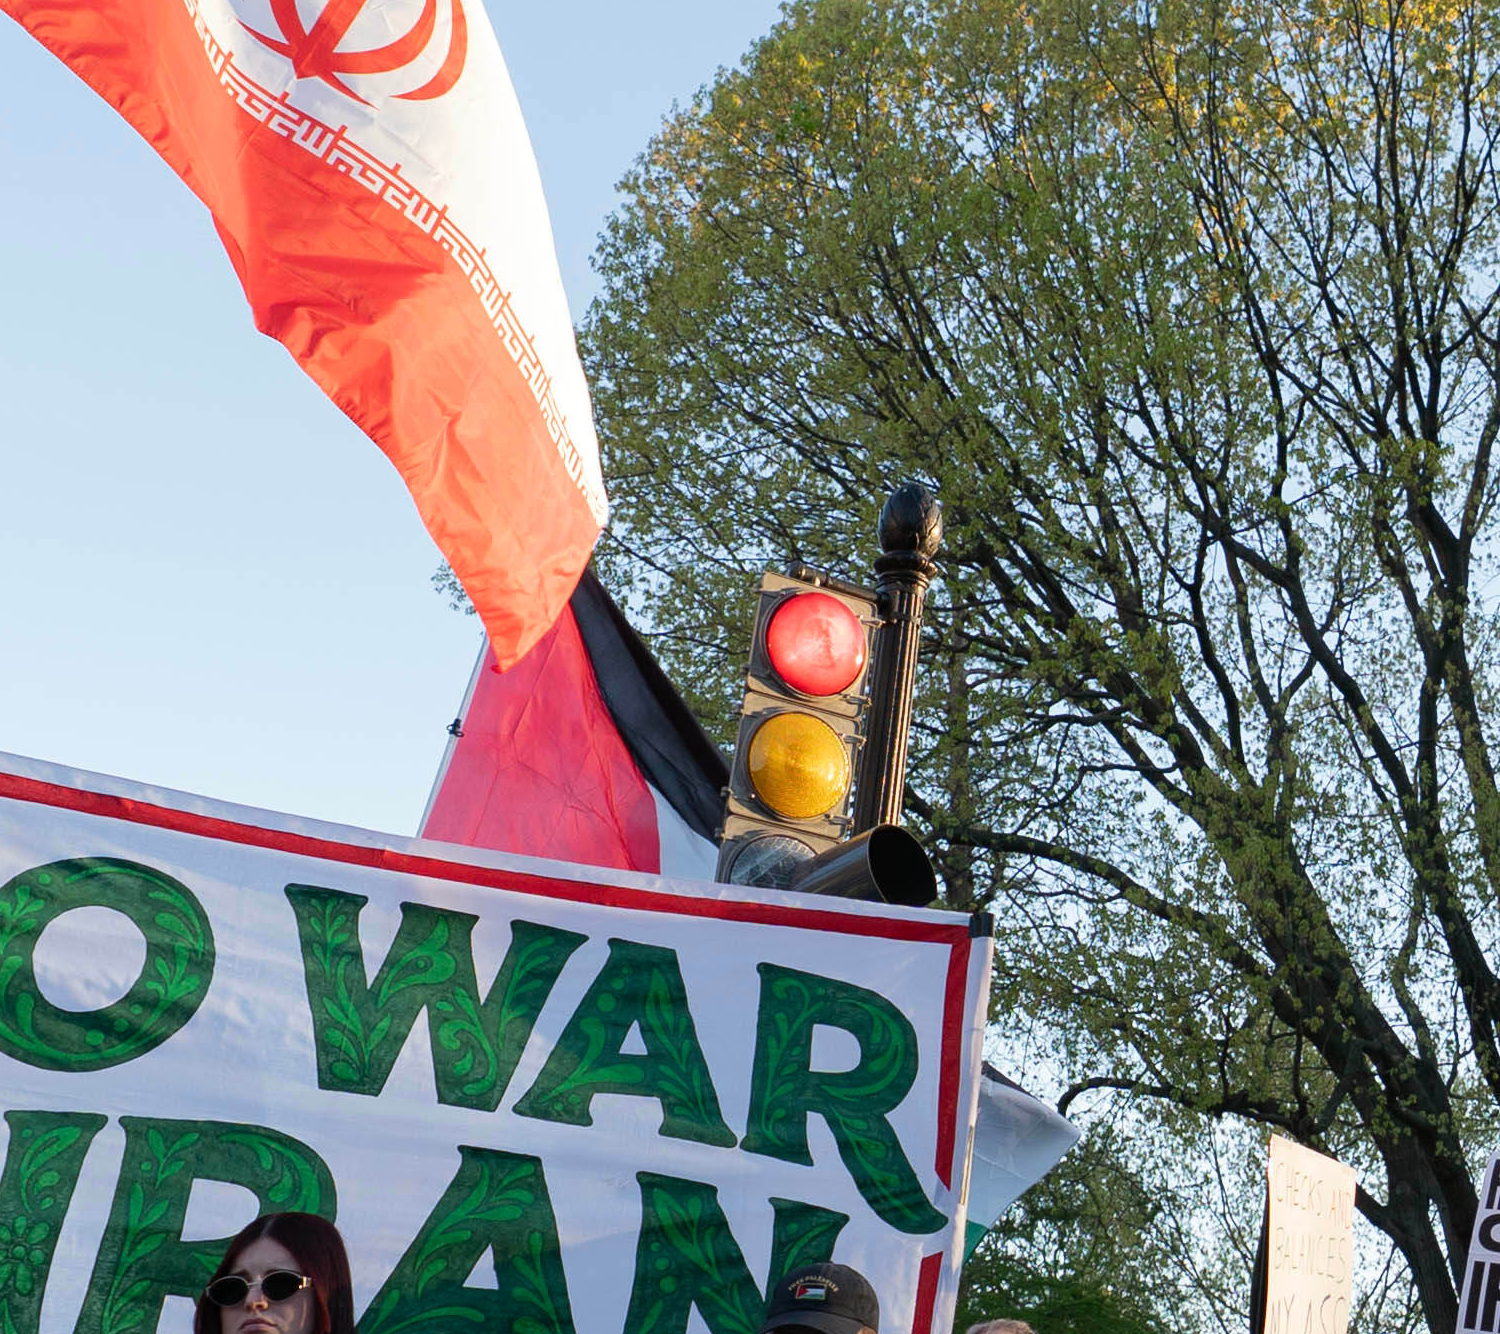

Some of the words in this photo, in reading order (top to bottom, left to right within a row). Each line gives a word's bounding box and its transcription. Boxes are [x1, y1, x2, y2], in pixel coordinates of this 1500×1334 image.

[285, 881, 950, 1237] WAR
[1276, 1161, 1325, 1217] CHECKS
[1330, 1192, 1352, 1231] AND
[1275, 1226, 1348, 1285] BALANCES
